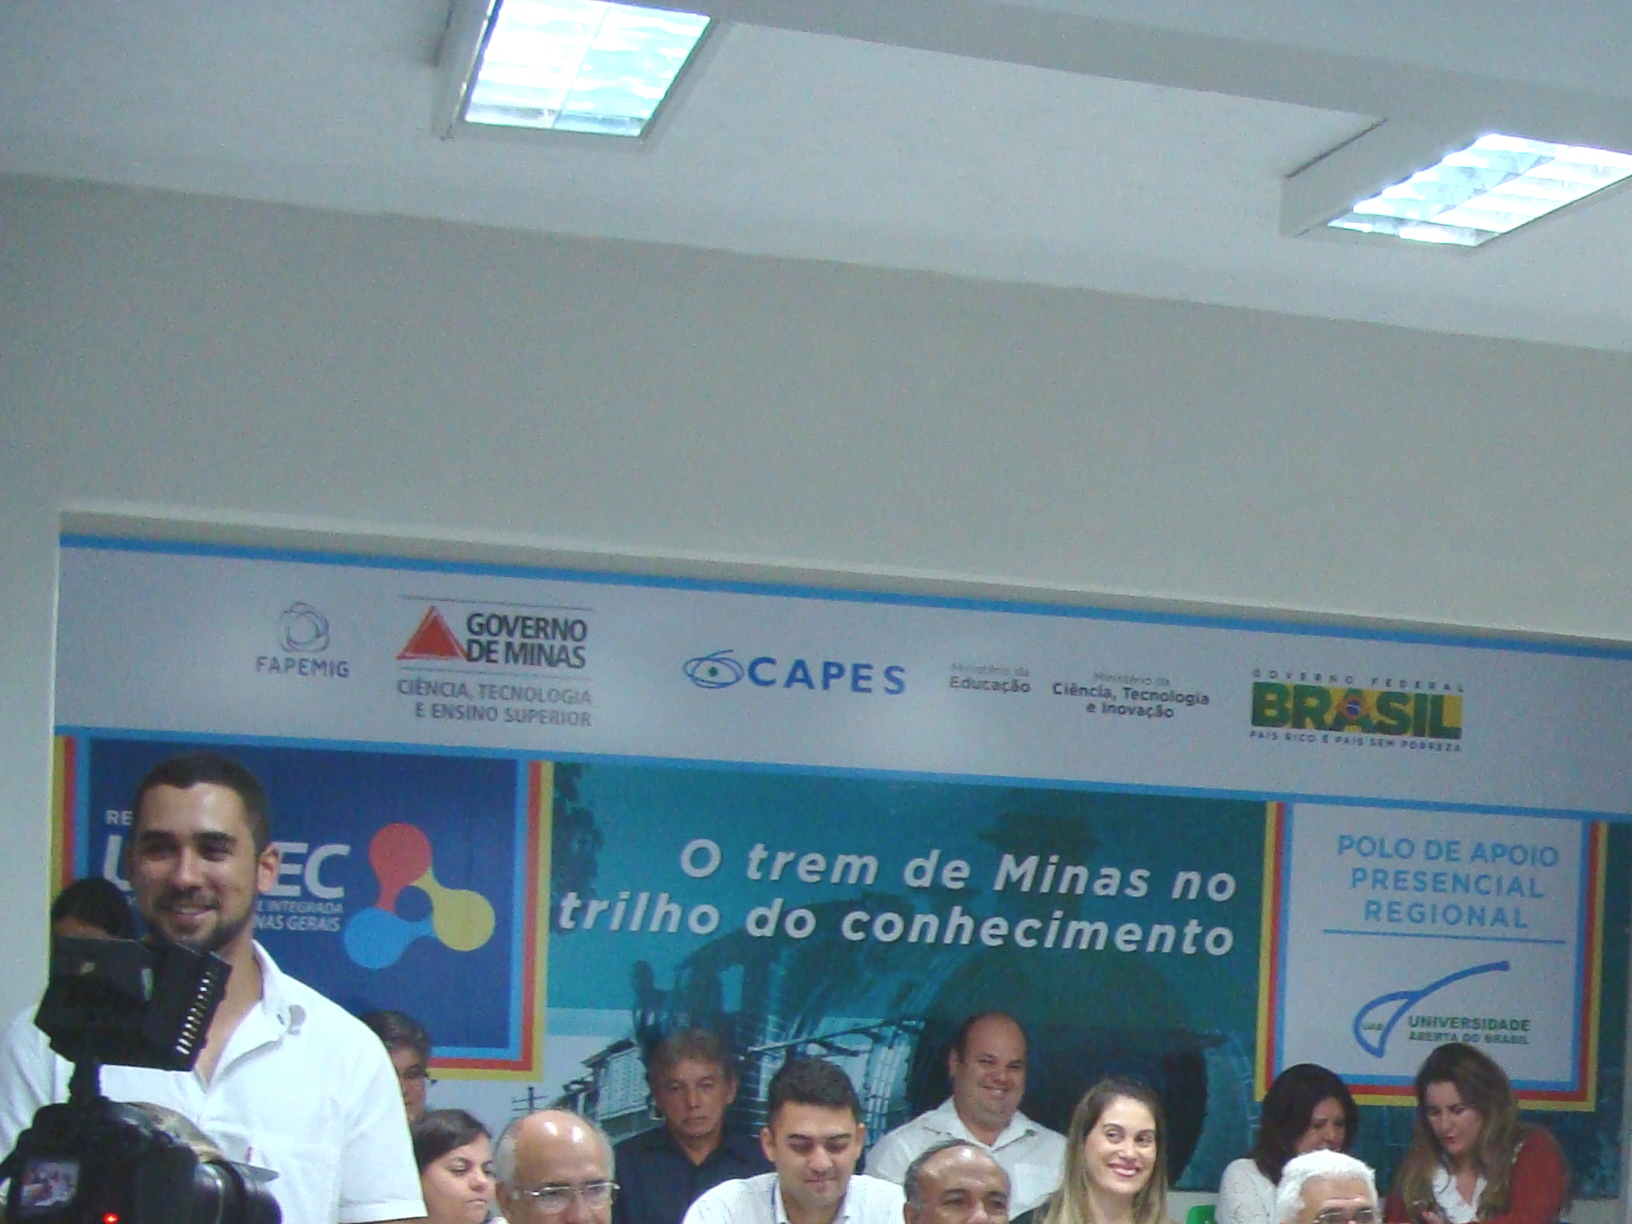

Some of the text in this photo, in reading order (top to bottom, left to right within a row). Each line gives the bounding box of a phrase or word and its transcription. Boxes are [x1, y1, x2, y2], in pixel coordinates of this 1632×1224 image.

[466, 612, 588, 643] GOVERNO
[255, 655, 351, 678] FAPEMIG
[466, 639, 587, 669] DE MINAS
[746, 655, 907, 696] CAPES
[949, 676, 1032, 694] Educação
[478, 683, 592, 706] TECNOLOGIA
[1052, 682, 1210, 707] Ciência, Tecnologia
[415, 701, 592, 728] E ENSINO SUPERIOR
[1085, 702, 1175, 719] e Inovação
[1251, 681, 1463, 740] BRASIL
[1337, 834, 1560, 868] POLO DE APOIO
[681, 838, 1237, 902] O trem de Minas no
[1351, 867, 1544, 898] PRESENCIAL
[286, 915, 341, 932] GERAIS
[559, 891, 1234, 956] trilho do conhecimento
[1364, 900, 1528, 929] REGIONAL
[1408, 1015, 1531, 1031] UNIVERSIDADE
